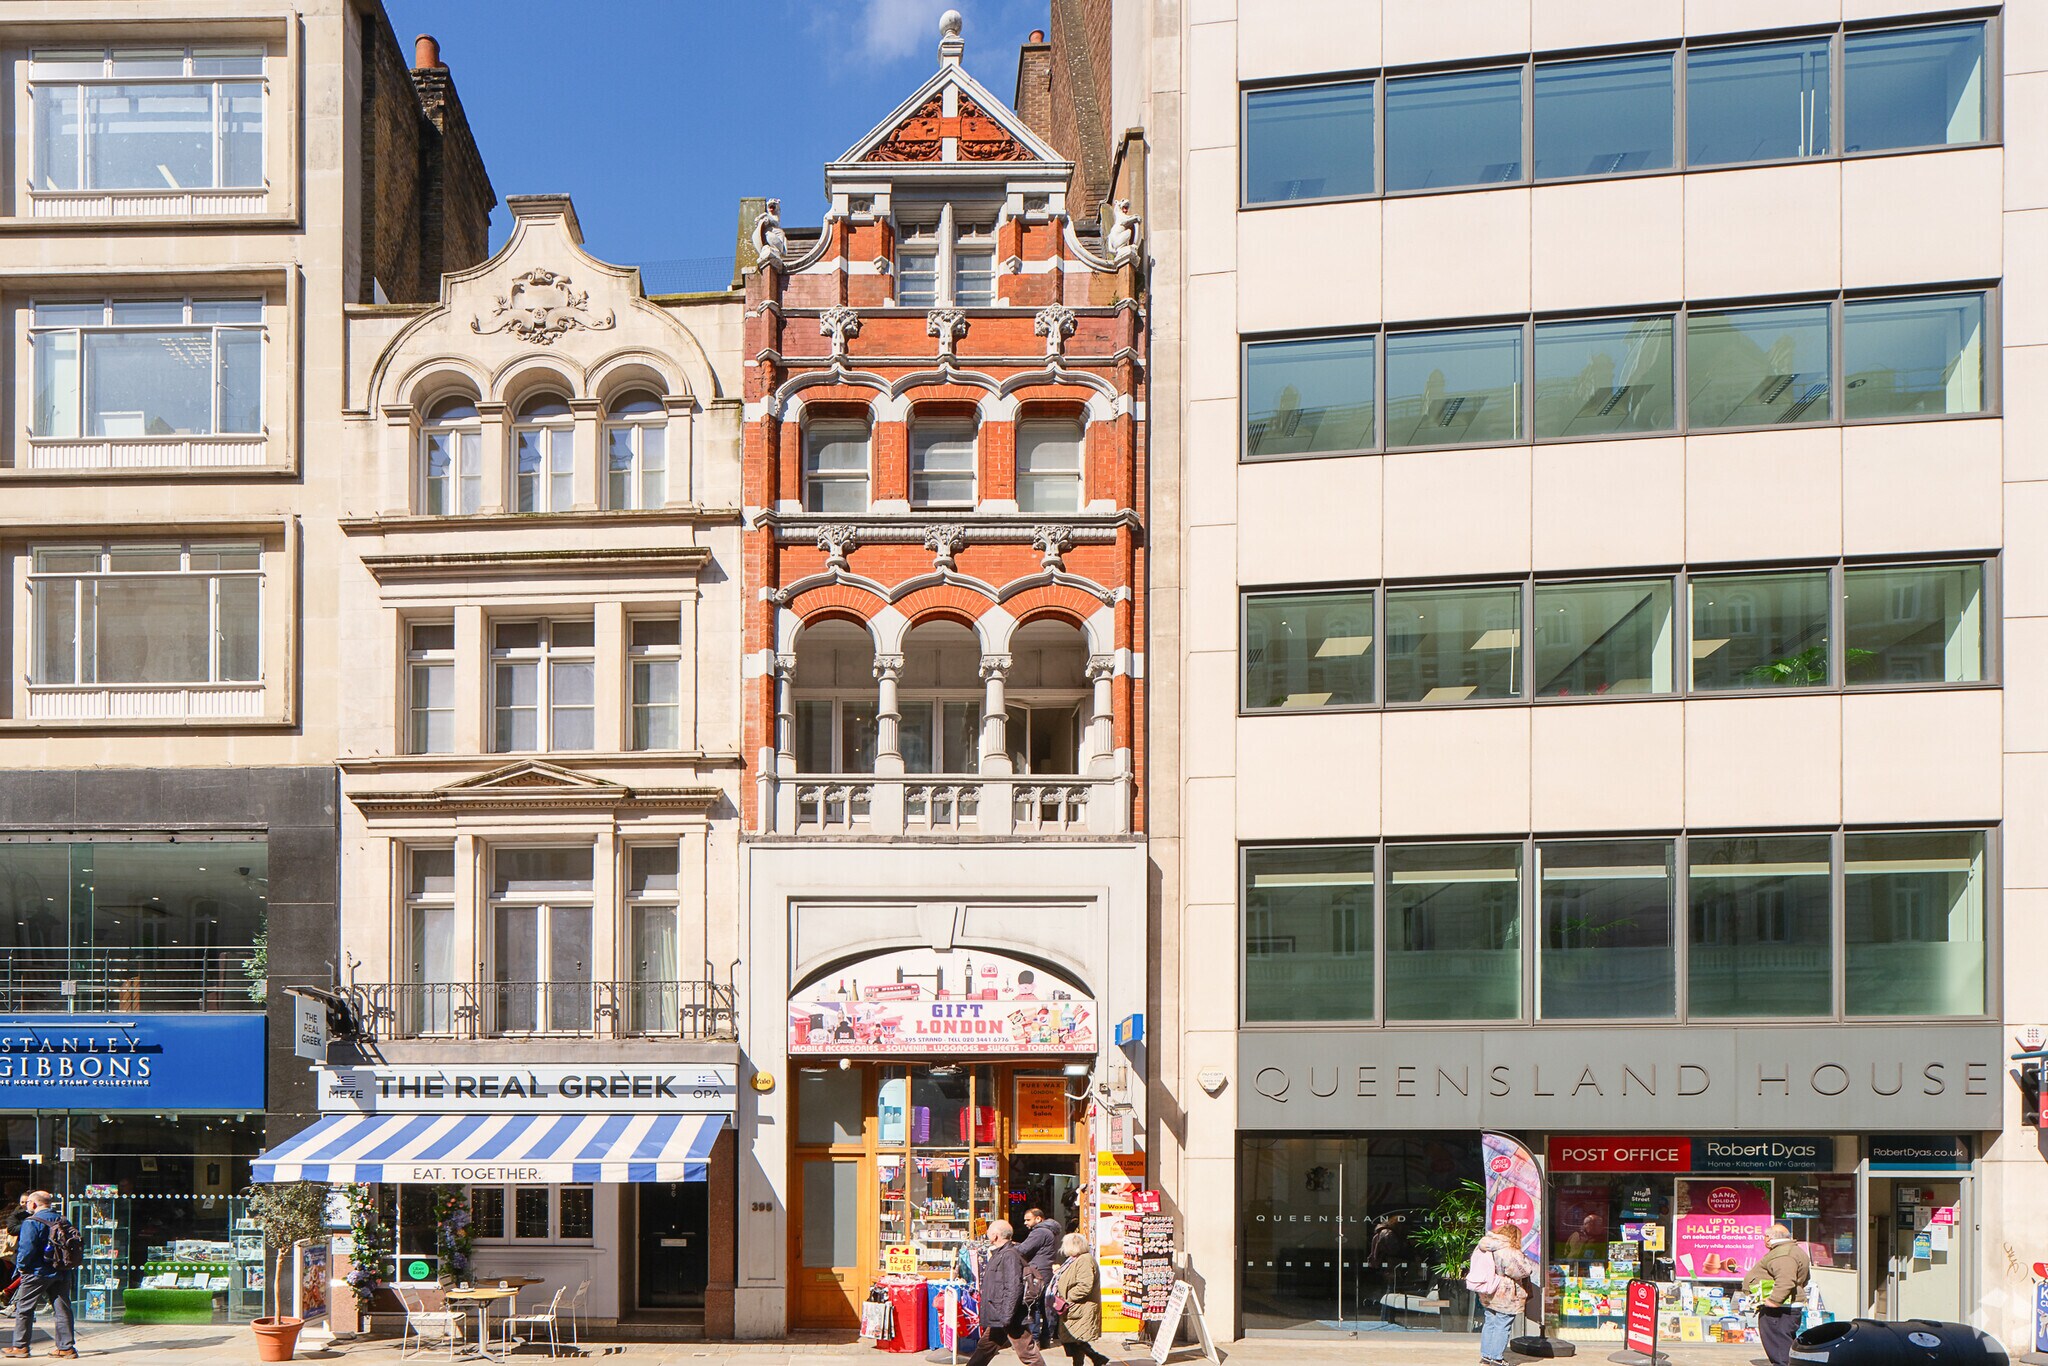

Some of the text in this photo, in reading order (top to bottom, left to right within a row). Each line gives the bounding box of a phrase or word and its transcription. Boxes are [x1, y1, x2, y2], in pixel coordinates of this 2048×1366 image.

[931, 1004, 984, 1018] GIFT
[305, 1012, 318, 1024] THE
[303, 1023, 320, 1035] REAL
[915, 1019, 1004, 1034] LONDON
[1, 1037, 141, 1053] STANLEY
[301, 1034, 322, 1047] GREEK
[791, 1044, 1095, 1053] MOBILE ACCESSORIES SOUVENIR LUGGAGES SWEETS TOBACCO VAPE
[0, 1056, 152, 1078] GIBBONS
[375, 1075, 678, 1099] THE REAL GREEK
[1254, 1061, 1988, 1103] QUEENSLAND HOUSE
[328, 1089, 364, 1099] MEZE
[692, 1089, 722, 1099] OPA
[1562, 1148, 1679, 1162] POST OFFICE
[1707, 1142, 1816, 1159] Robert Dyas
[1873, 1147, 1964, 1158] RobertDyas.co.uk
[1707, 1160, 1816, 1168] Home Kitchen DIY Garden
[413, 1167, 542, 1180] EAT. TOGETHER.
[1008, 1193, 1027, 1201] PEN
[751, 1202, 773, 1212] 395
[1255, 1213, 1485, 1224] QUEENSLAND HOUS
[1494, 1218, 1529, 1226] Chnge
[1686, 1225, 1763, 1234] HALF PRICE
[889, 1256, 899, 1264] £2
[902, 1264, 912, 1272] £5
